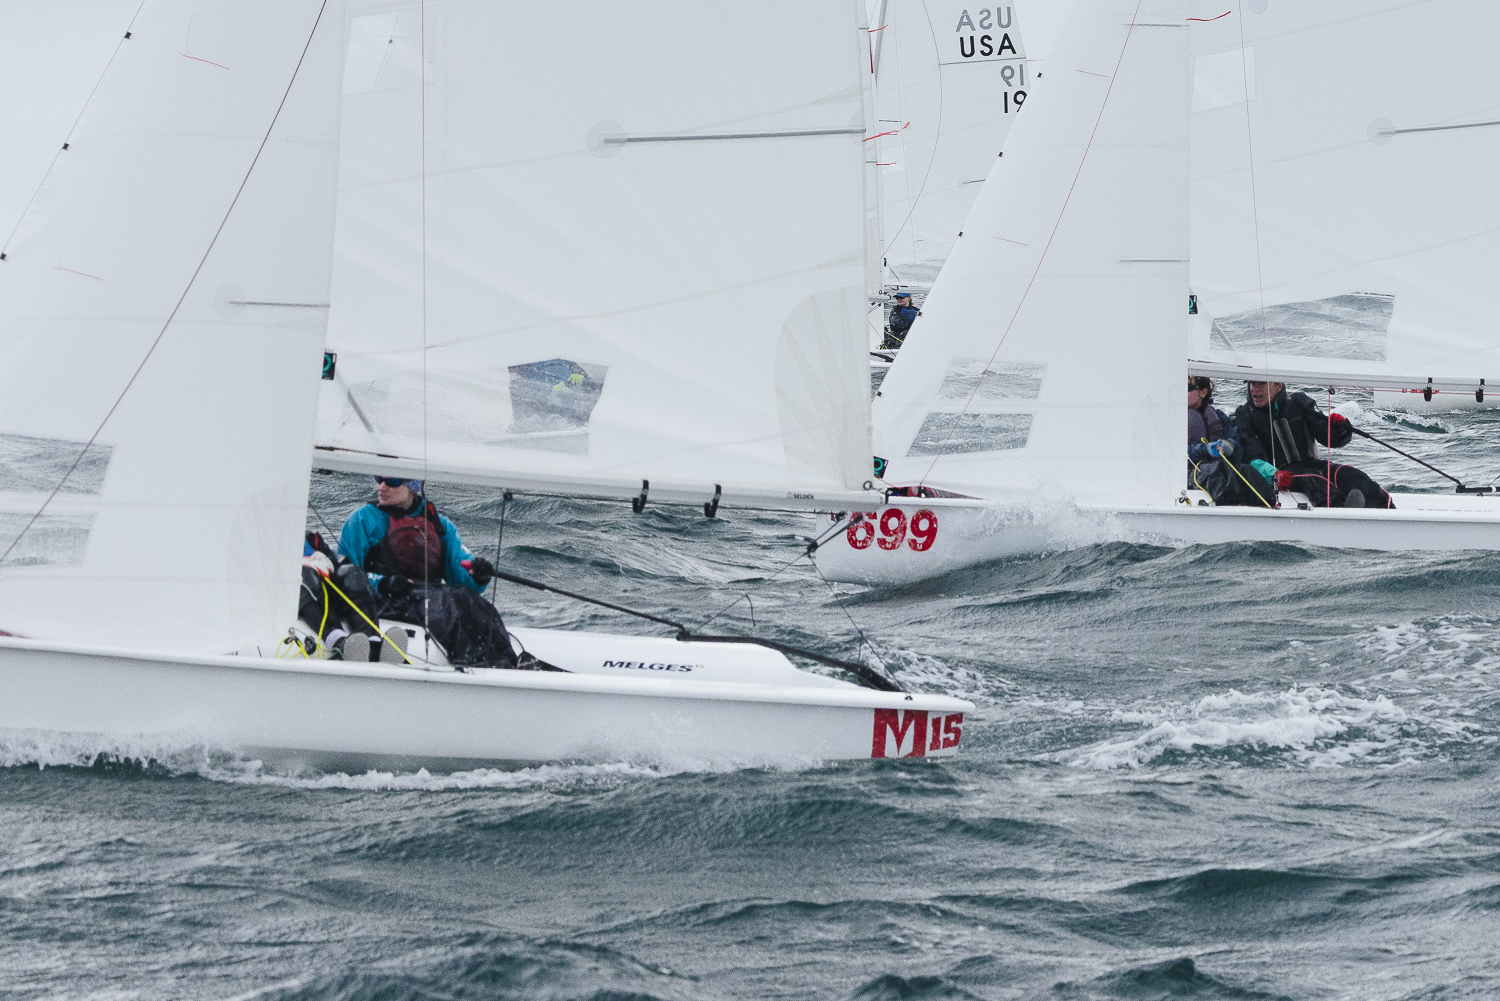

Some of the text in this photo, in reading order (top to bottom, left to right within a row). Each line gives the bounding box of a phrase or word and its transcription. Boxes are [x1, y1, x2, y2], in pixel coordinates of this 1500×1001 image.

[960, 33, 1016, 57] USA
[1004, 91, 1027, 113] 19
[847, 508, 938, 551] 699
[603, 660, 693, 672] MELGES
